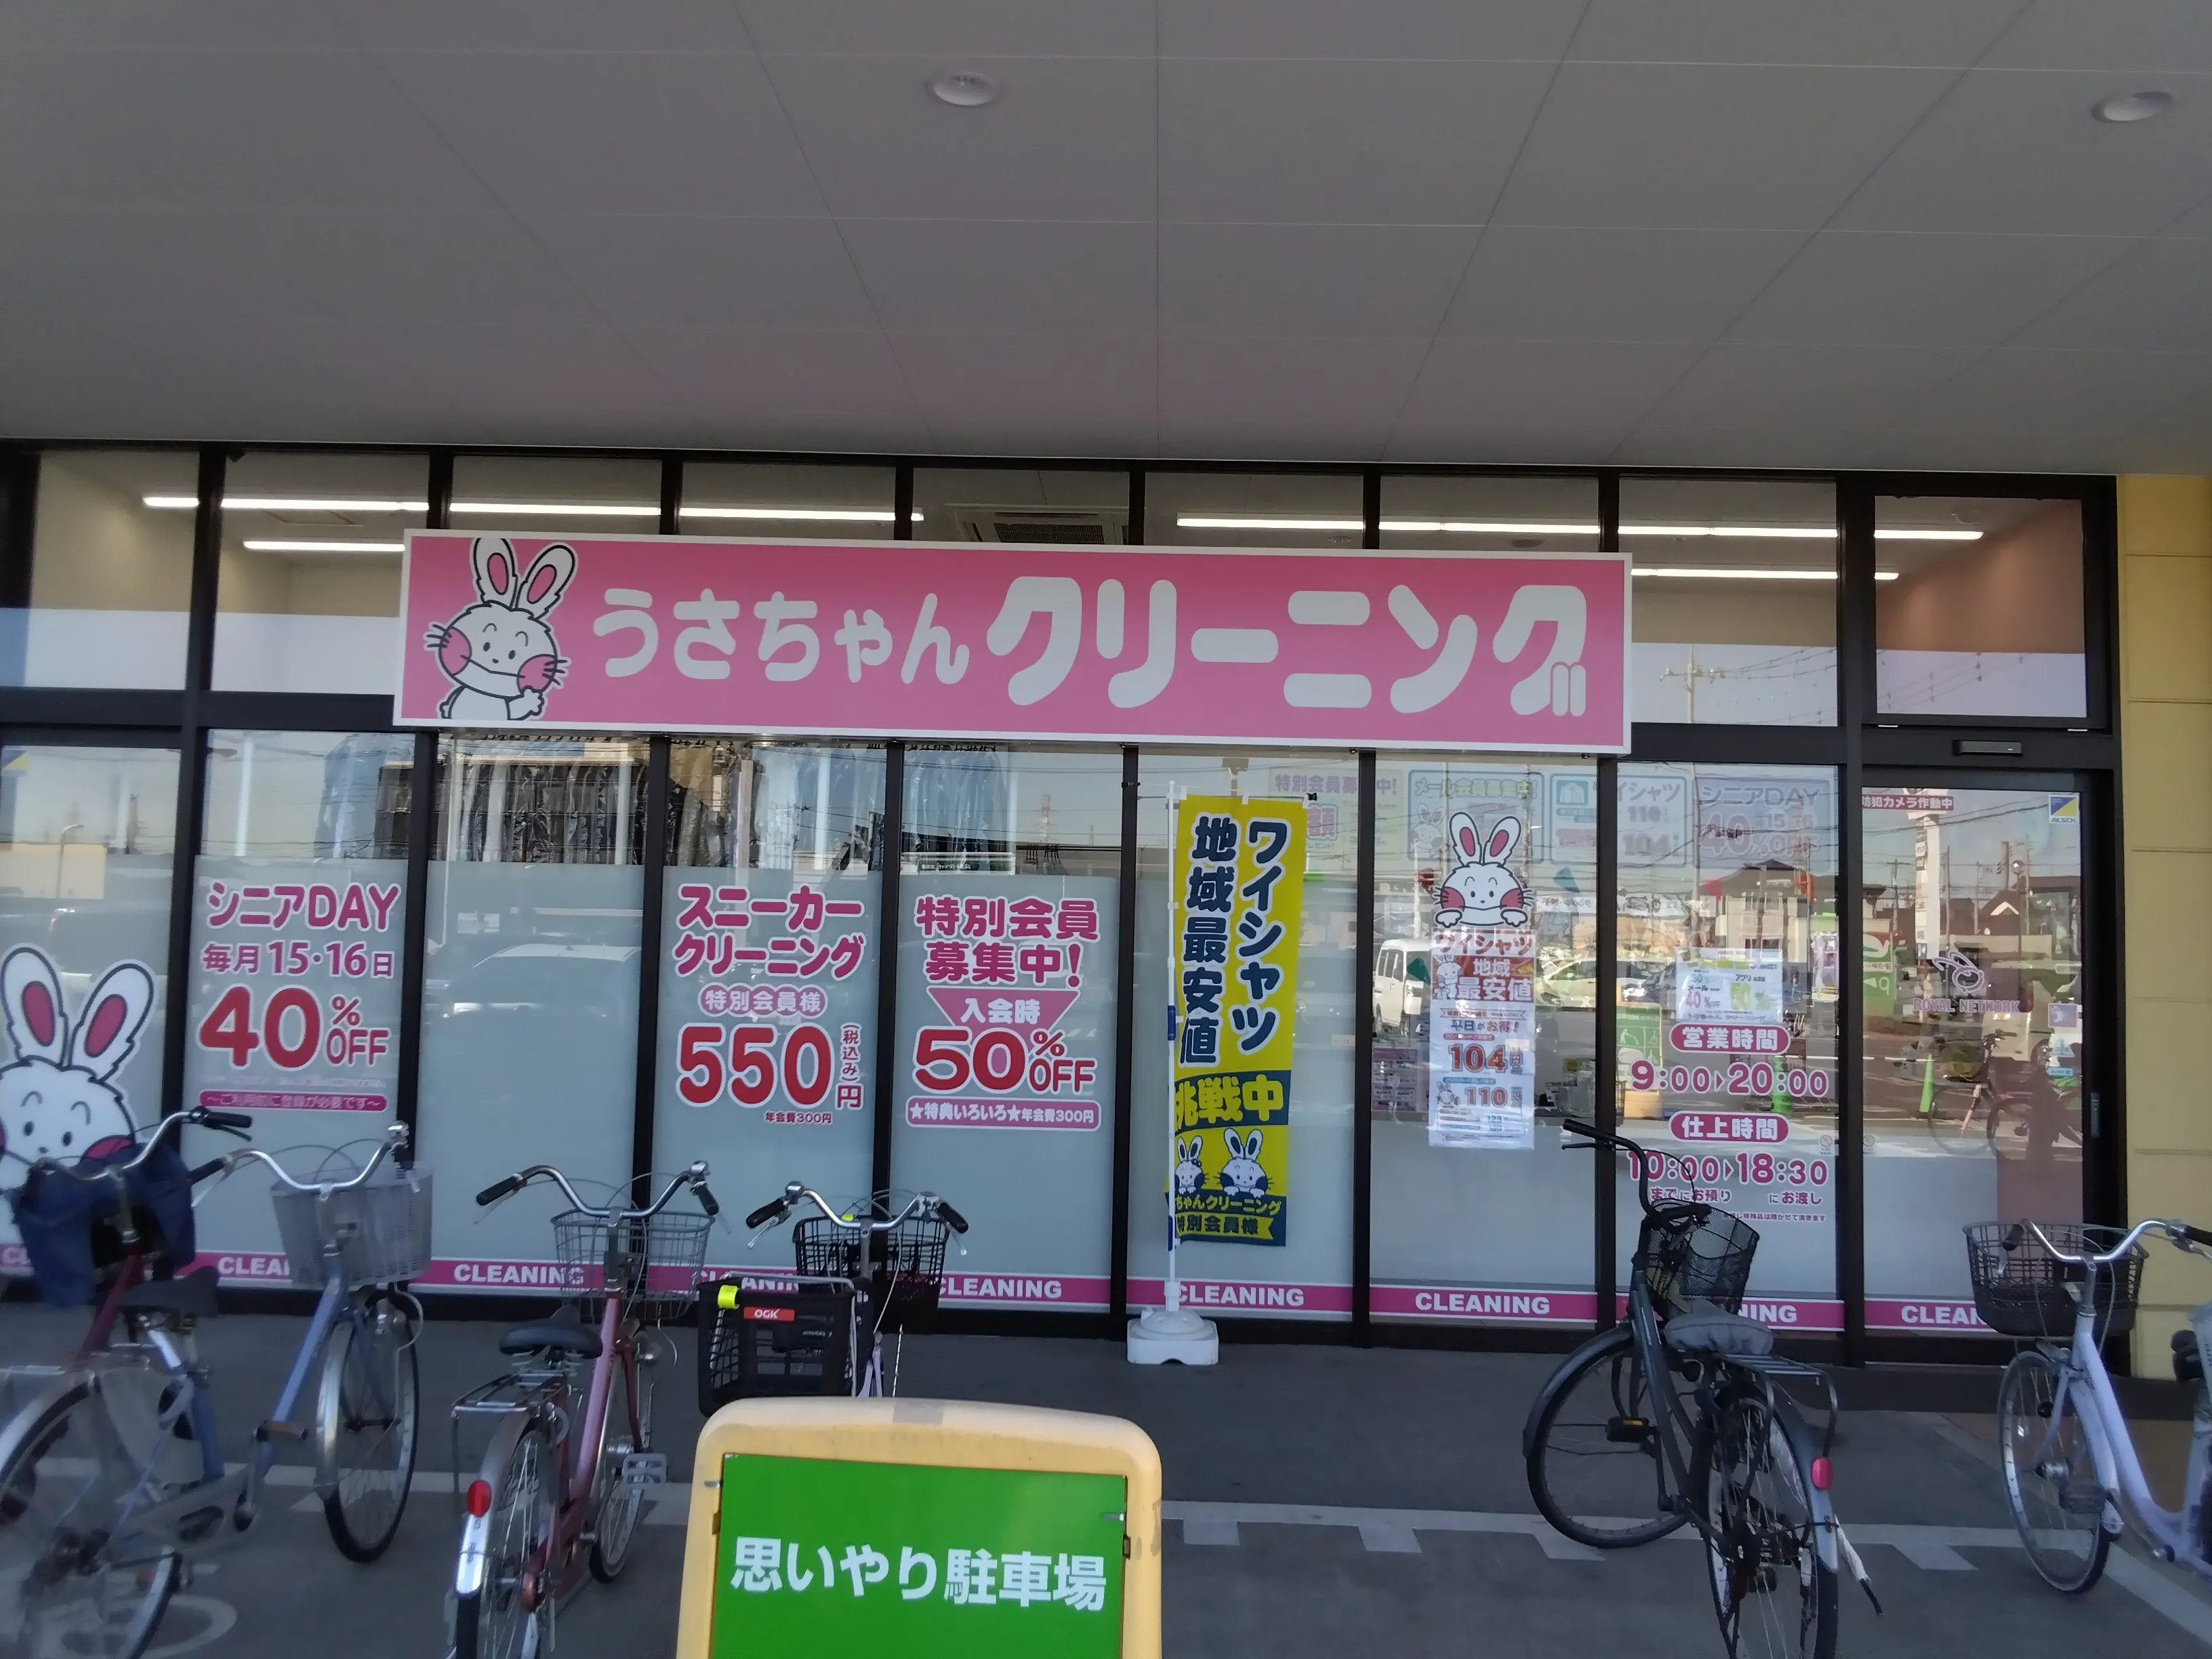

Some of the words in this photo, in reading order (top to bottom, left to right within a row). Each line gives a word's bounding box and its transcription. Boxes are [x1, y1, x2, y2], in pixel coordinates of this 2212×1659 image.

[593, 576, 1586, 717] うさちゃんクリーニング
[1275, 773, 1397, 796] 特別会員募中!
[1593, 781, 1681, 803] イシャツ
[1701, 785, 1822, 807] シニアDAY
[207, 882, 400, 931] シニアDAY
[678, 884, 865, 931] スニーカー
[915, 895, 1101, 941] 特別会員
[1180, 813, 1240, 1067] 地域最安値
[1230, 819, 1290, 1053] ワイシャツ
[1435, 933, 1533, 956] ワイシャツ
[673, 933, 865, 980] クリーニング
[924, 941, 1084, 989] 募集中!
[1472, 958, 1511, 977] 地域
[705, 989, 823, 1013] 特別会員様
[1456, 977, 1533, 1001] 最安値
[960, 998, 1040, 1025] 入会時
[1913, 998, 1955, 1013] ROYAL
[1959, 999, 2020, 1013] NETWORK
[1681, 1027, 1778, 1051] 営業時間
[677, 1023, 836, 1108] 550
[1448, 1044, 1508, 1073] 104
[1465, 1086, 1509, 1107] 110
[764, 1111, 833, 1124] 年会費300円
[1681, 1116, 1778, 1141] 仕上時間
[1768, 1191, 1823, 1205] にお渡し
[453, 1263, 585, 1285] CLEANING
[754, 1308, 781, 1319] OGK
[1414, 1292, 1551, 1315] CLEANING
[730, 1535, 1108, 1613] 思いやり駐車場
